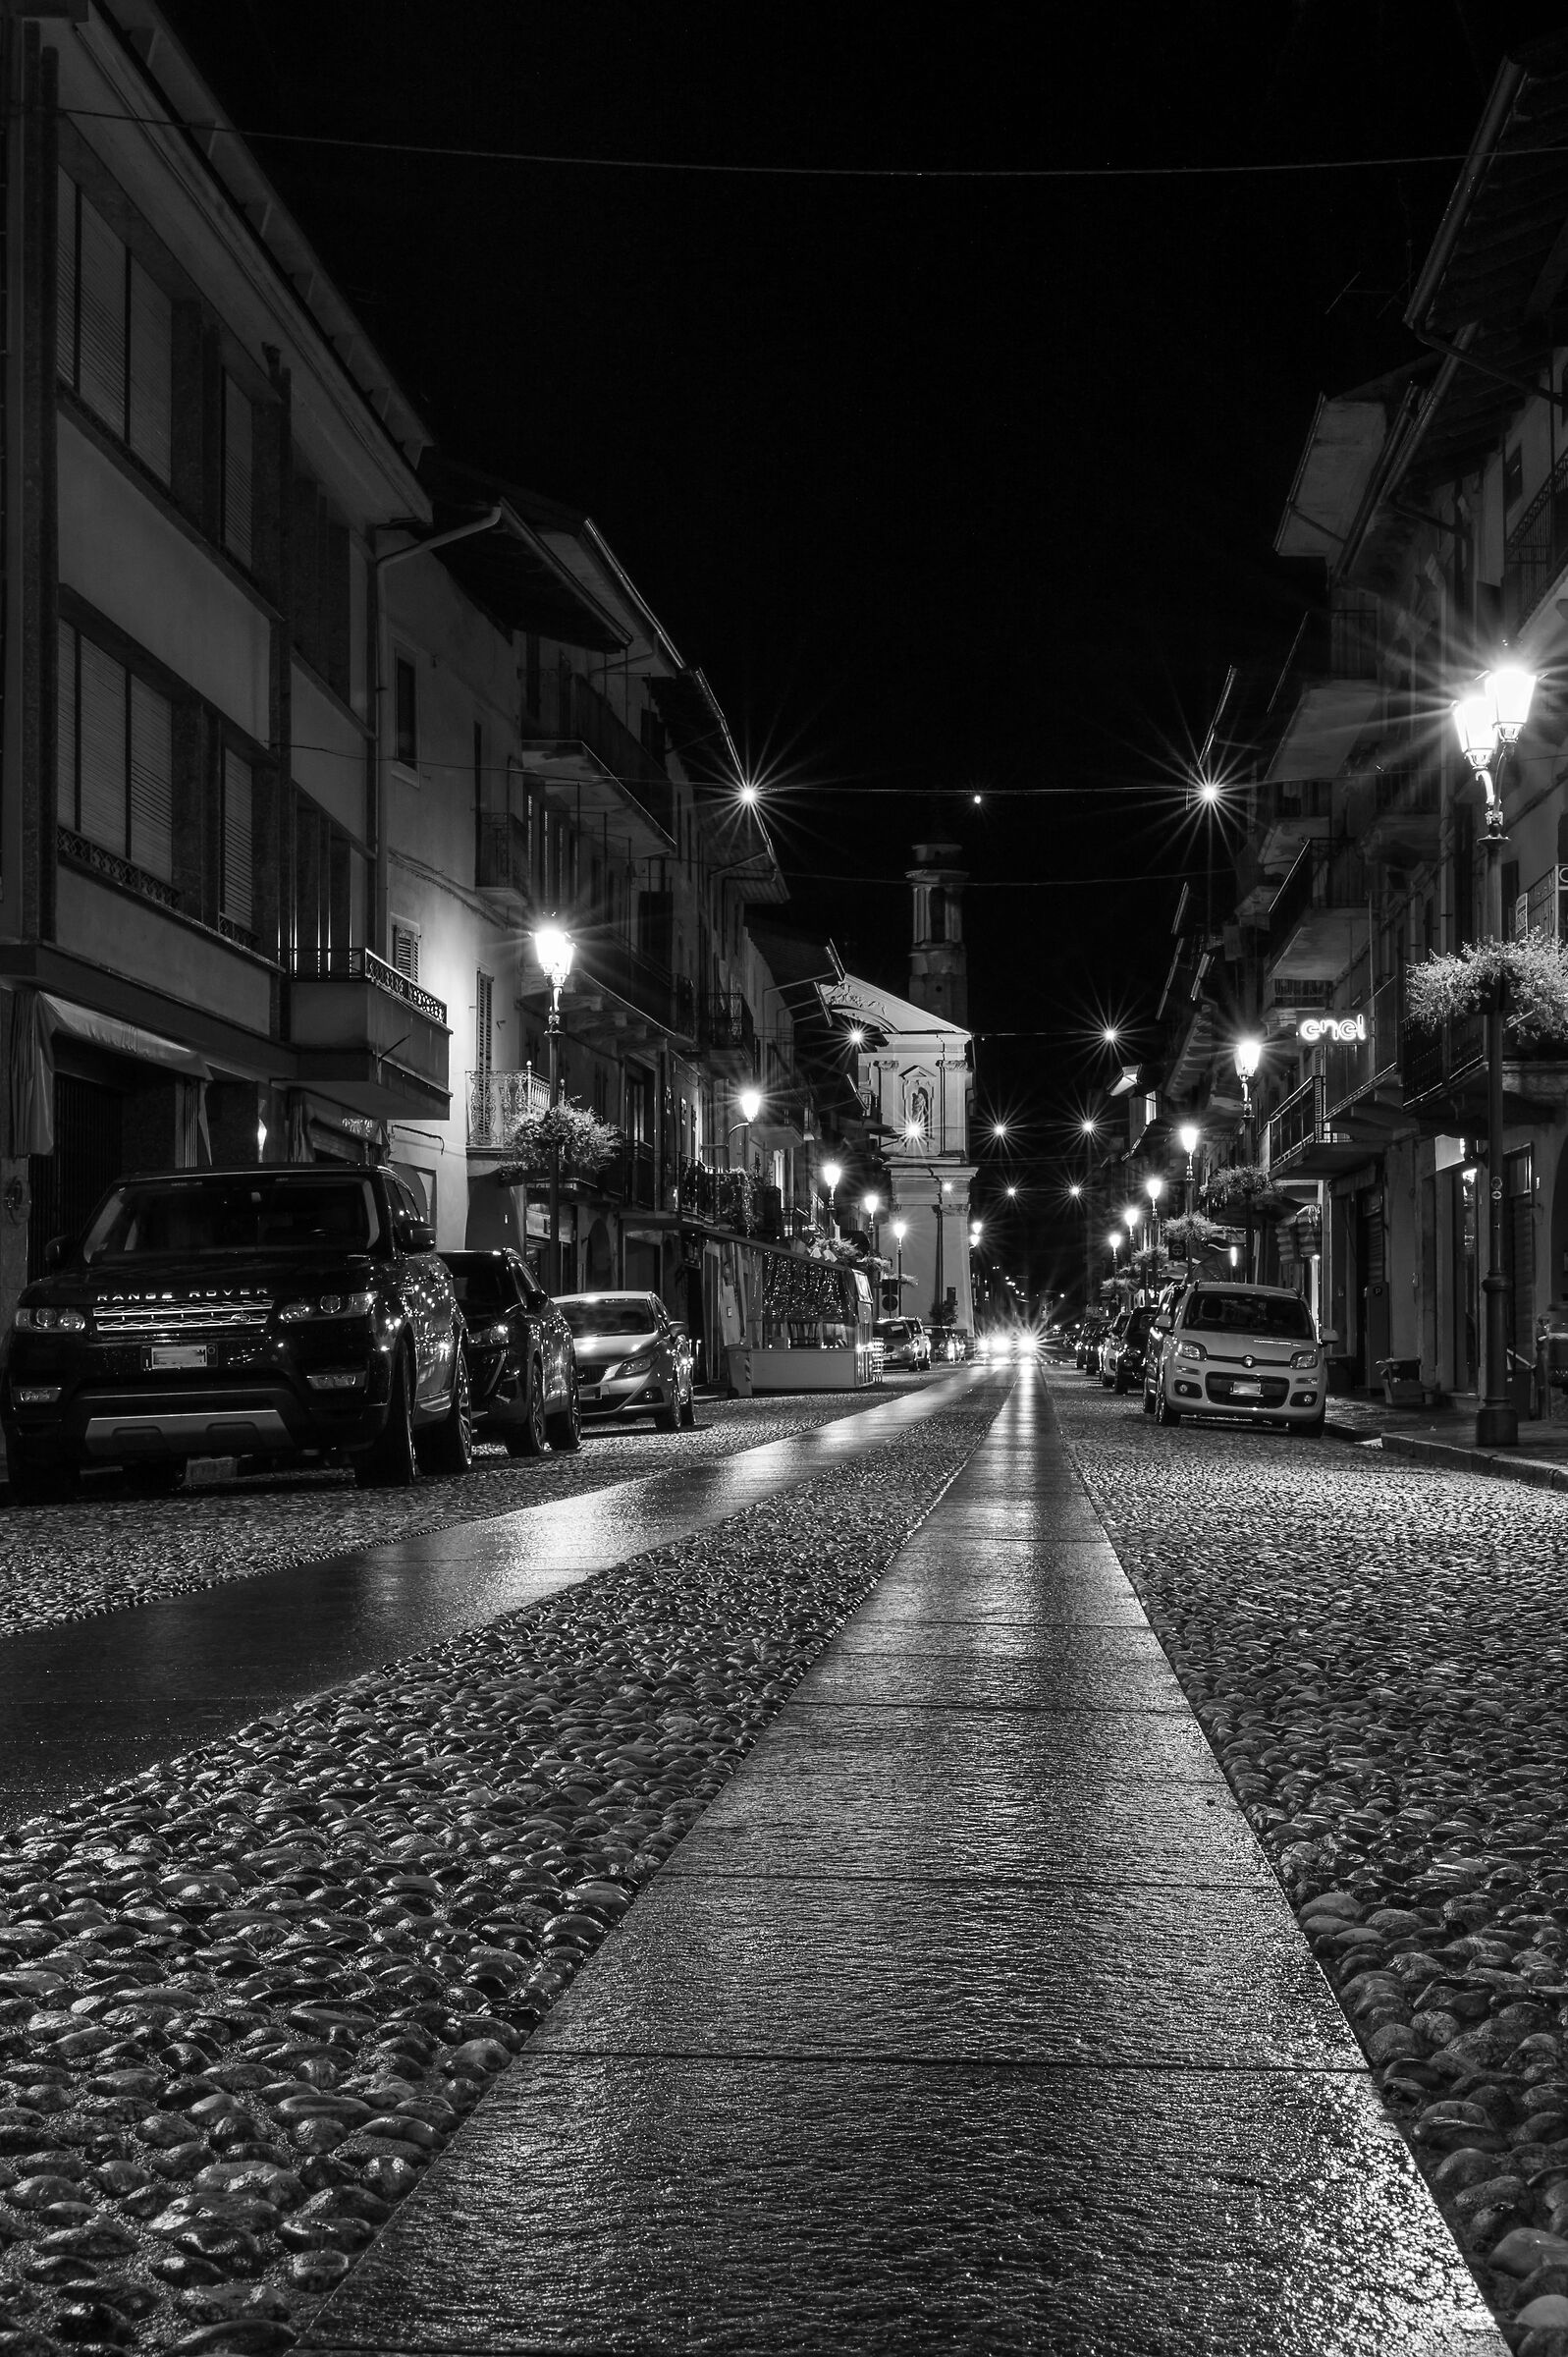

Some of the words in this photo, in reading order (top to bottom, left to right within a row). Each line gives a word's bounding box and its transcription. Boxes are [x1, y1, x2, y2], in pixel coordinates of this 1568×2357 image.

[1300, 1014, 1366, 1041] enel
[96, 1291, 174, 1301] RANGE
[189, 1288, 268, 1298] ROVER
